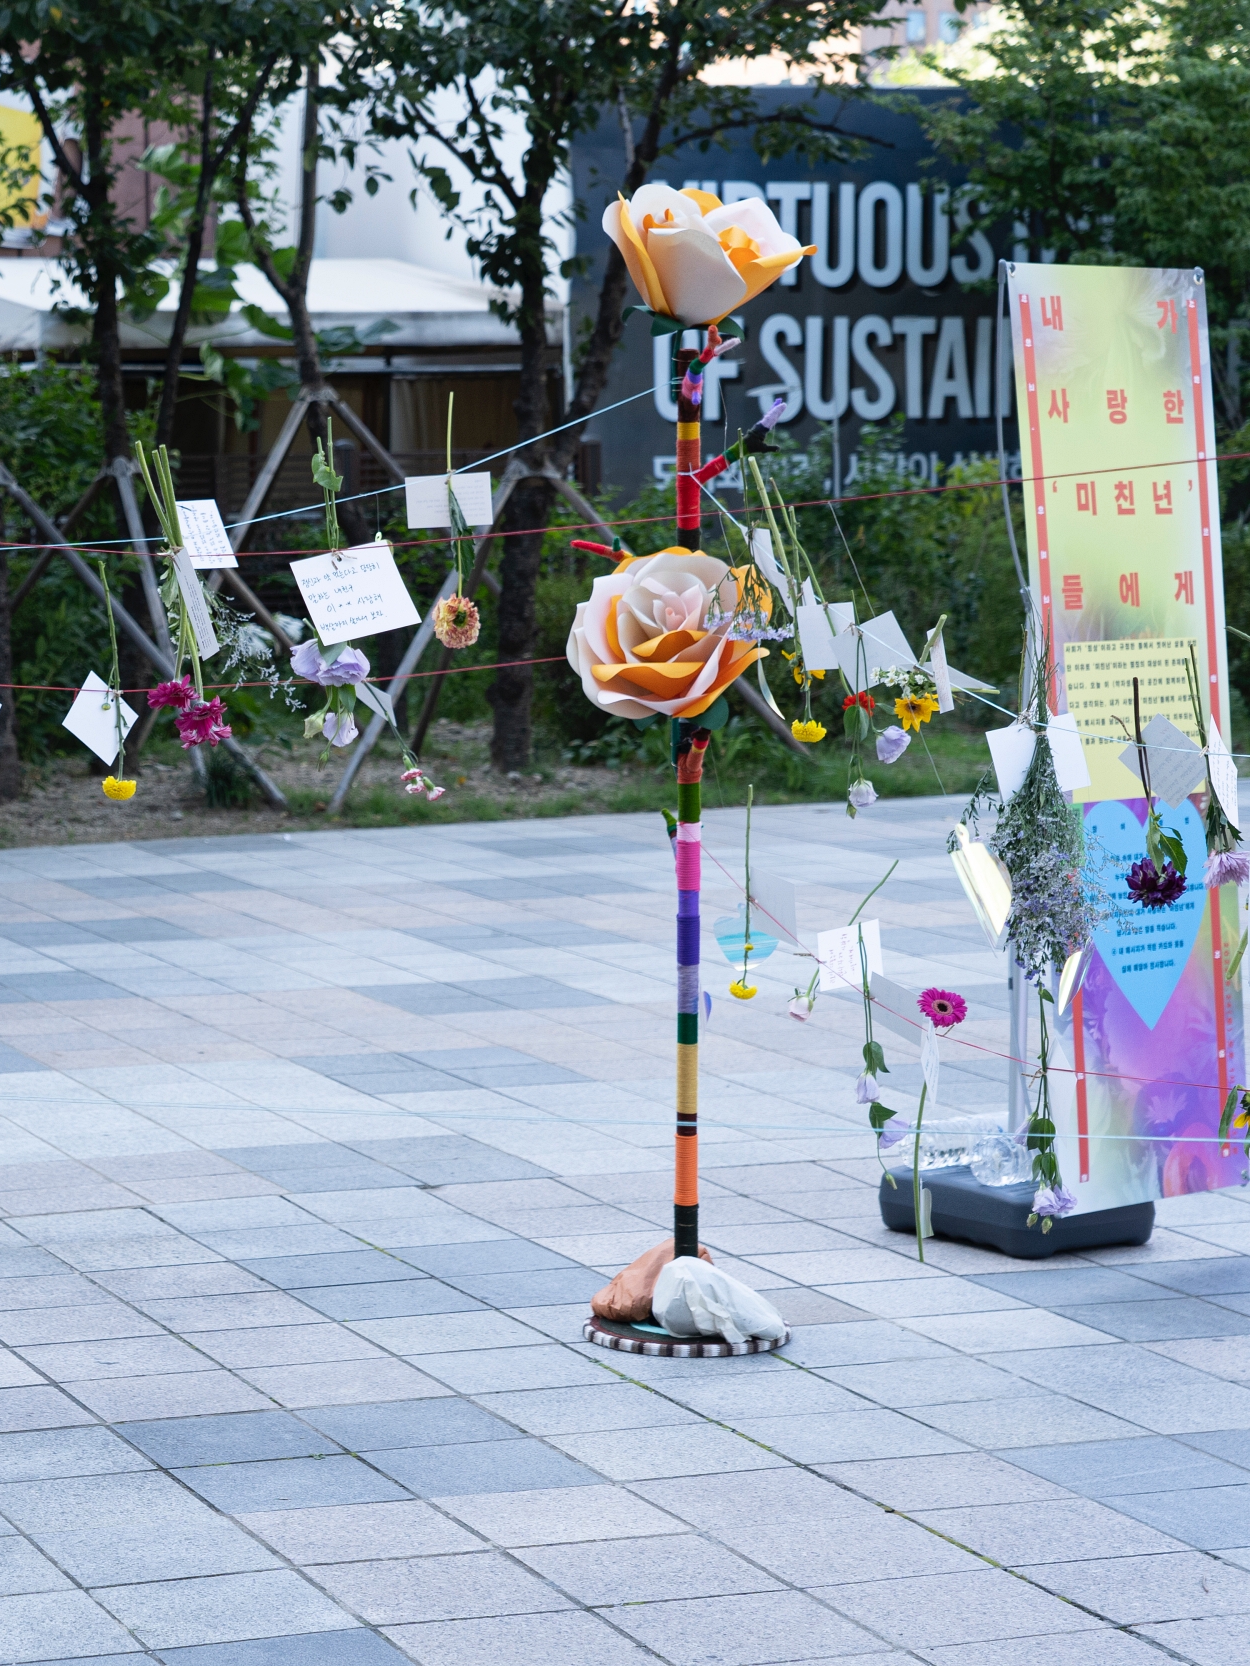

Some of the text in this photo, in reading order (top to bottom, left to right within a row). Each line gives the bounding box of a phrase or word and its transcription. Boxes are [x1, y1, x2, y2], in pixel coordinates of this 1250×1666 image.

[1048, 388, 1185, 425] 사랑한
[332, 567, 358, 579] 먹는다고
[1062, 571, 1195, 610] 들에게
[308, 591, 330, 604] 말하는
[357, 593, 384, 606] 사랑해
